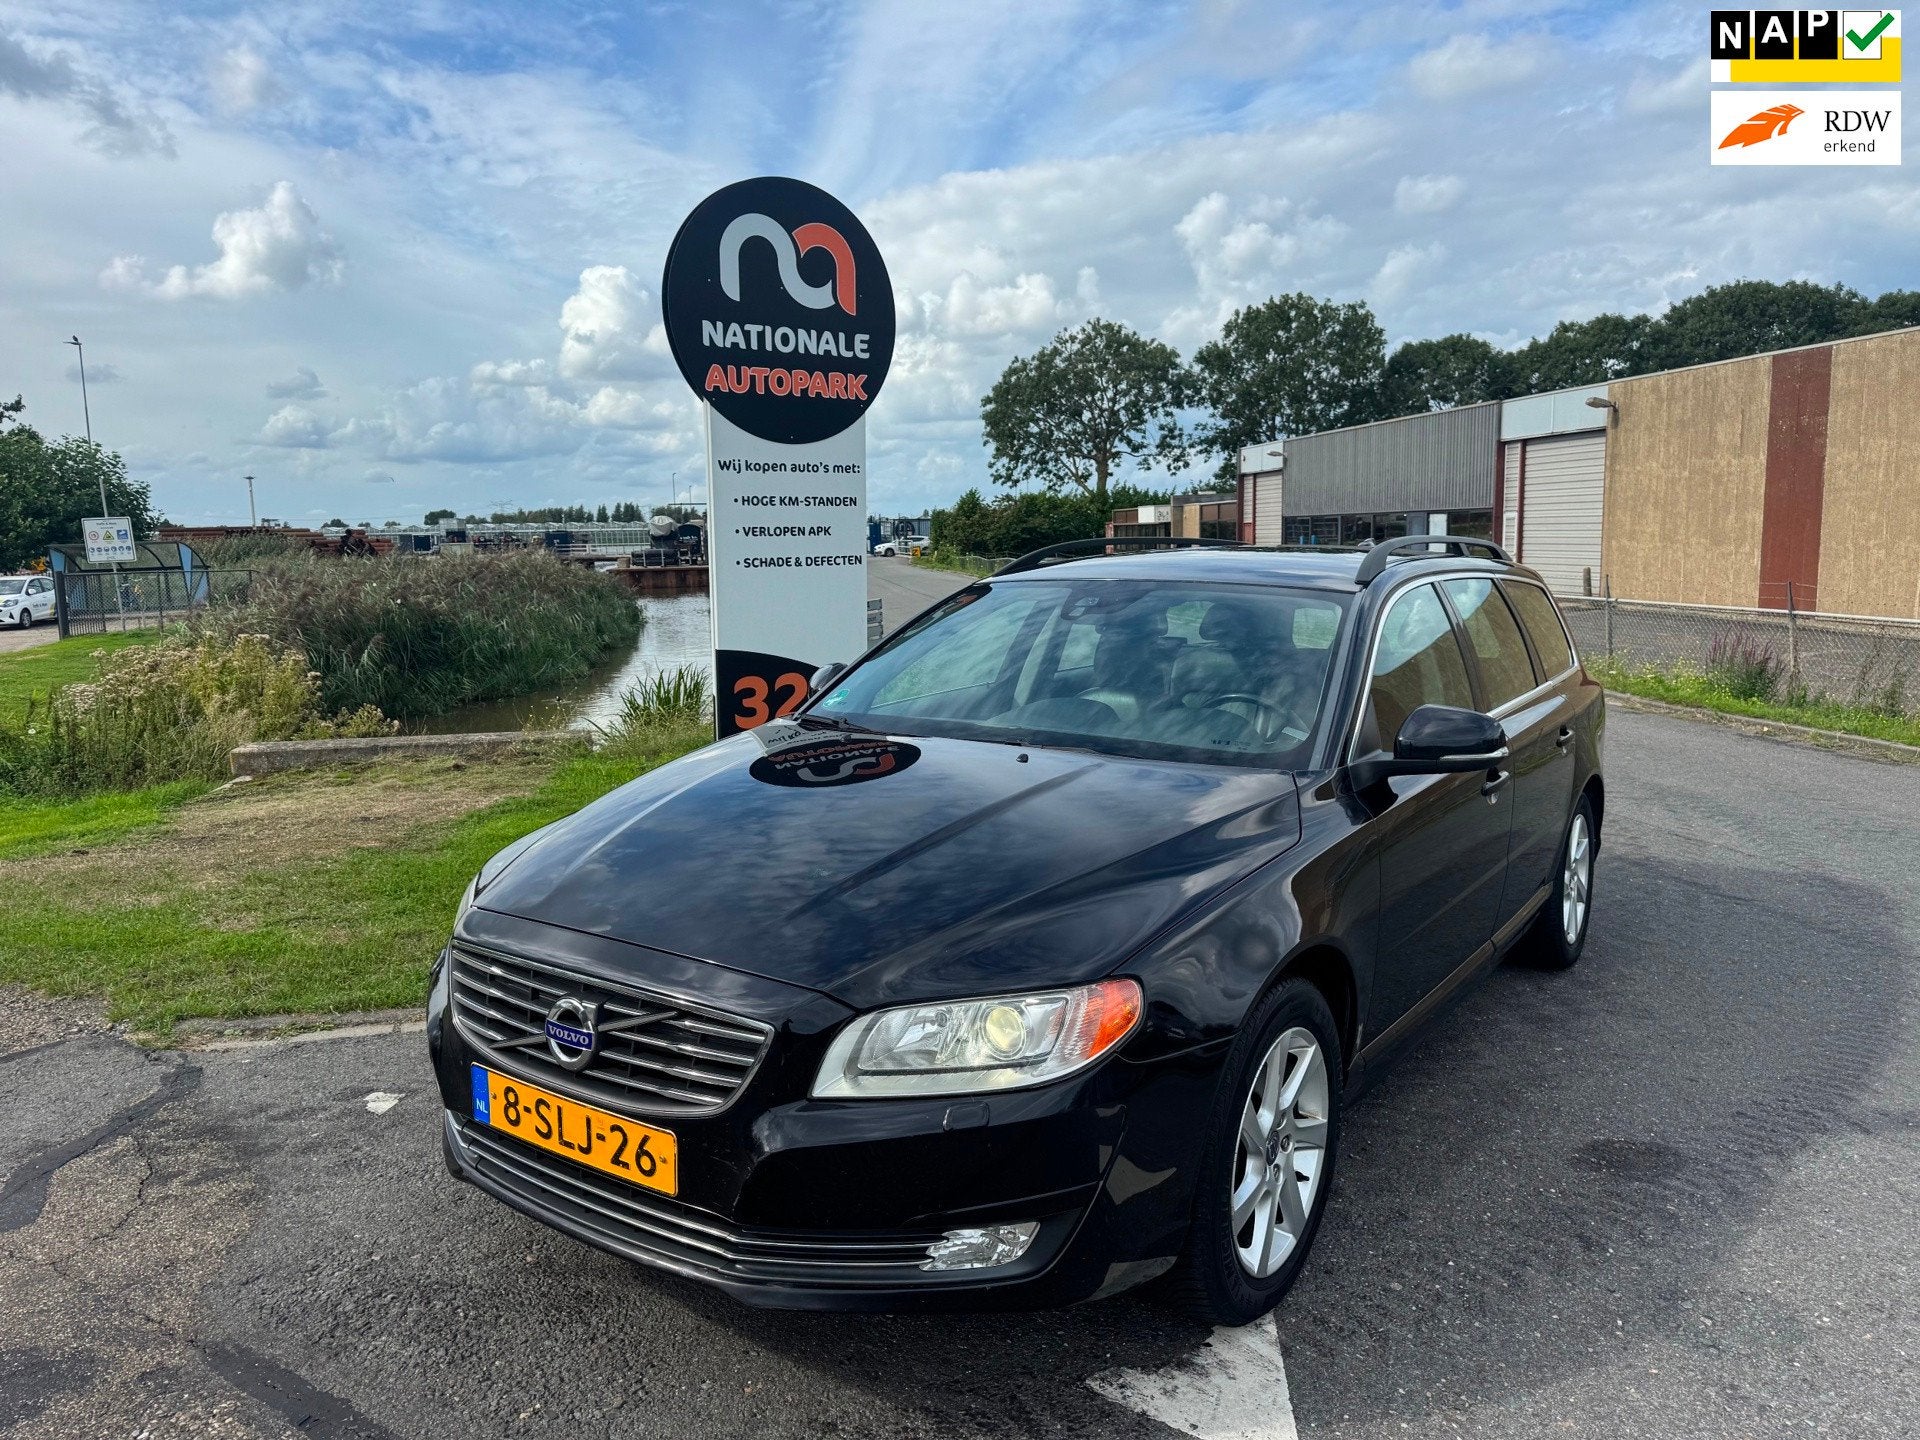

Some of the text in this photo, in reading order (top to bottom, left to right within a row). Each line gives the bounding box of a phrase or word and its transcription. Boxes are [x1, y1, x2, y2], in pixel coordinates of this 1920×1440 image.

[702, 319, 870, 359] NATIONALE
[705, 363, 868, 401] AUTOPARK
[718, 459, 861, 474] Wij kopen auto's met:
[741, 495, 857, 507] HOGE KM-STANDEN
[742, 526, 832, 537] VERLOPEN APK
[743, 555, 862, 568] SCHADE & DEFECTEN
[733, 672, 808, 730] 32
[547, 1024, 589, 1046] VOLVO
[476, 1098, 488, 1114] NL
[503, 1085, 657, 1178] 8-SLJ-26
